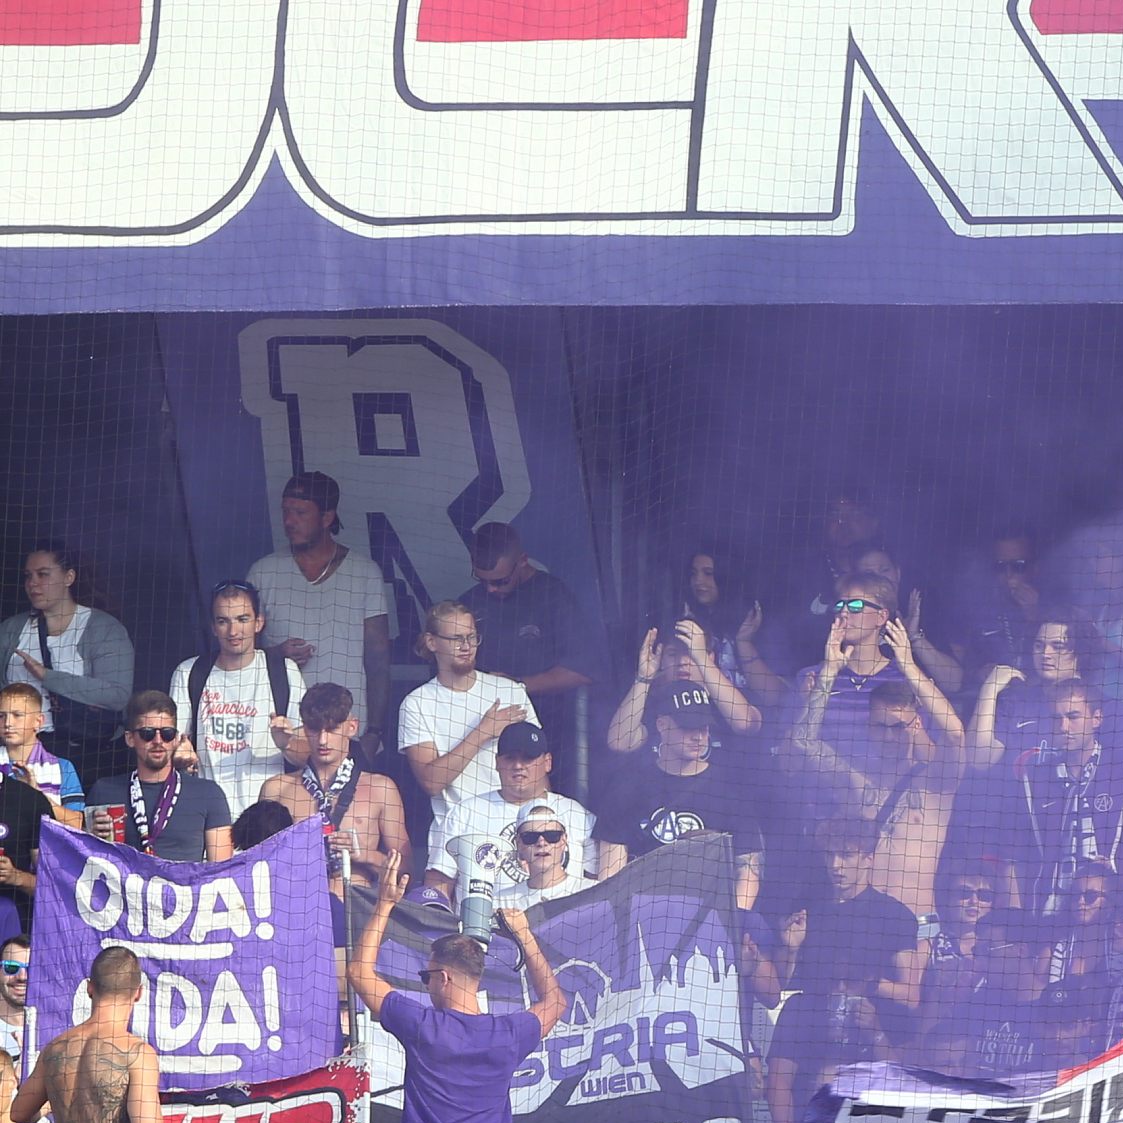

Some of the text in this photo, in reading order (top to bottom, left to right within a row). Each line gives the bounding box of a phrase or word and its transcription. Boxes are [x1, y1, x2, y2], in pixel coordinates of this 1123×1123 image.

[673, 690, 710, 709] ICON
[211, 716, 244, 740] 1968
[205, 736, 234, 754] ESPRIT
[75, 856, 275, 942] OIDA!
[580, 1072, 646, 1098] WIEN
